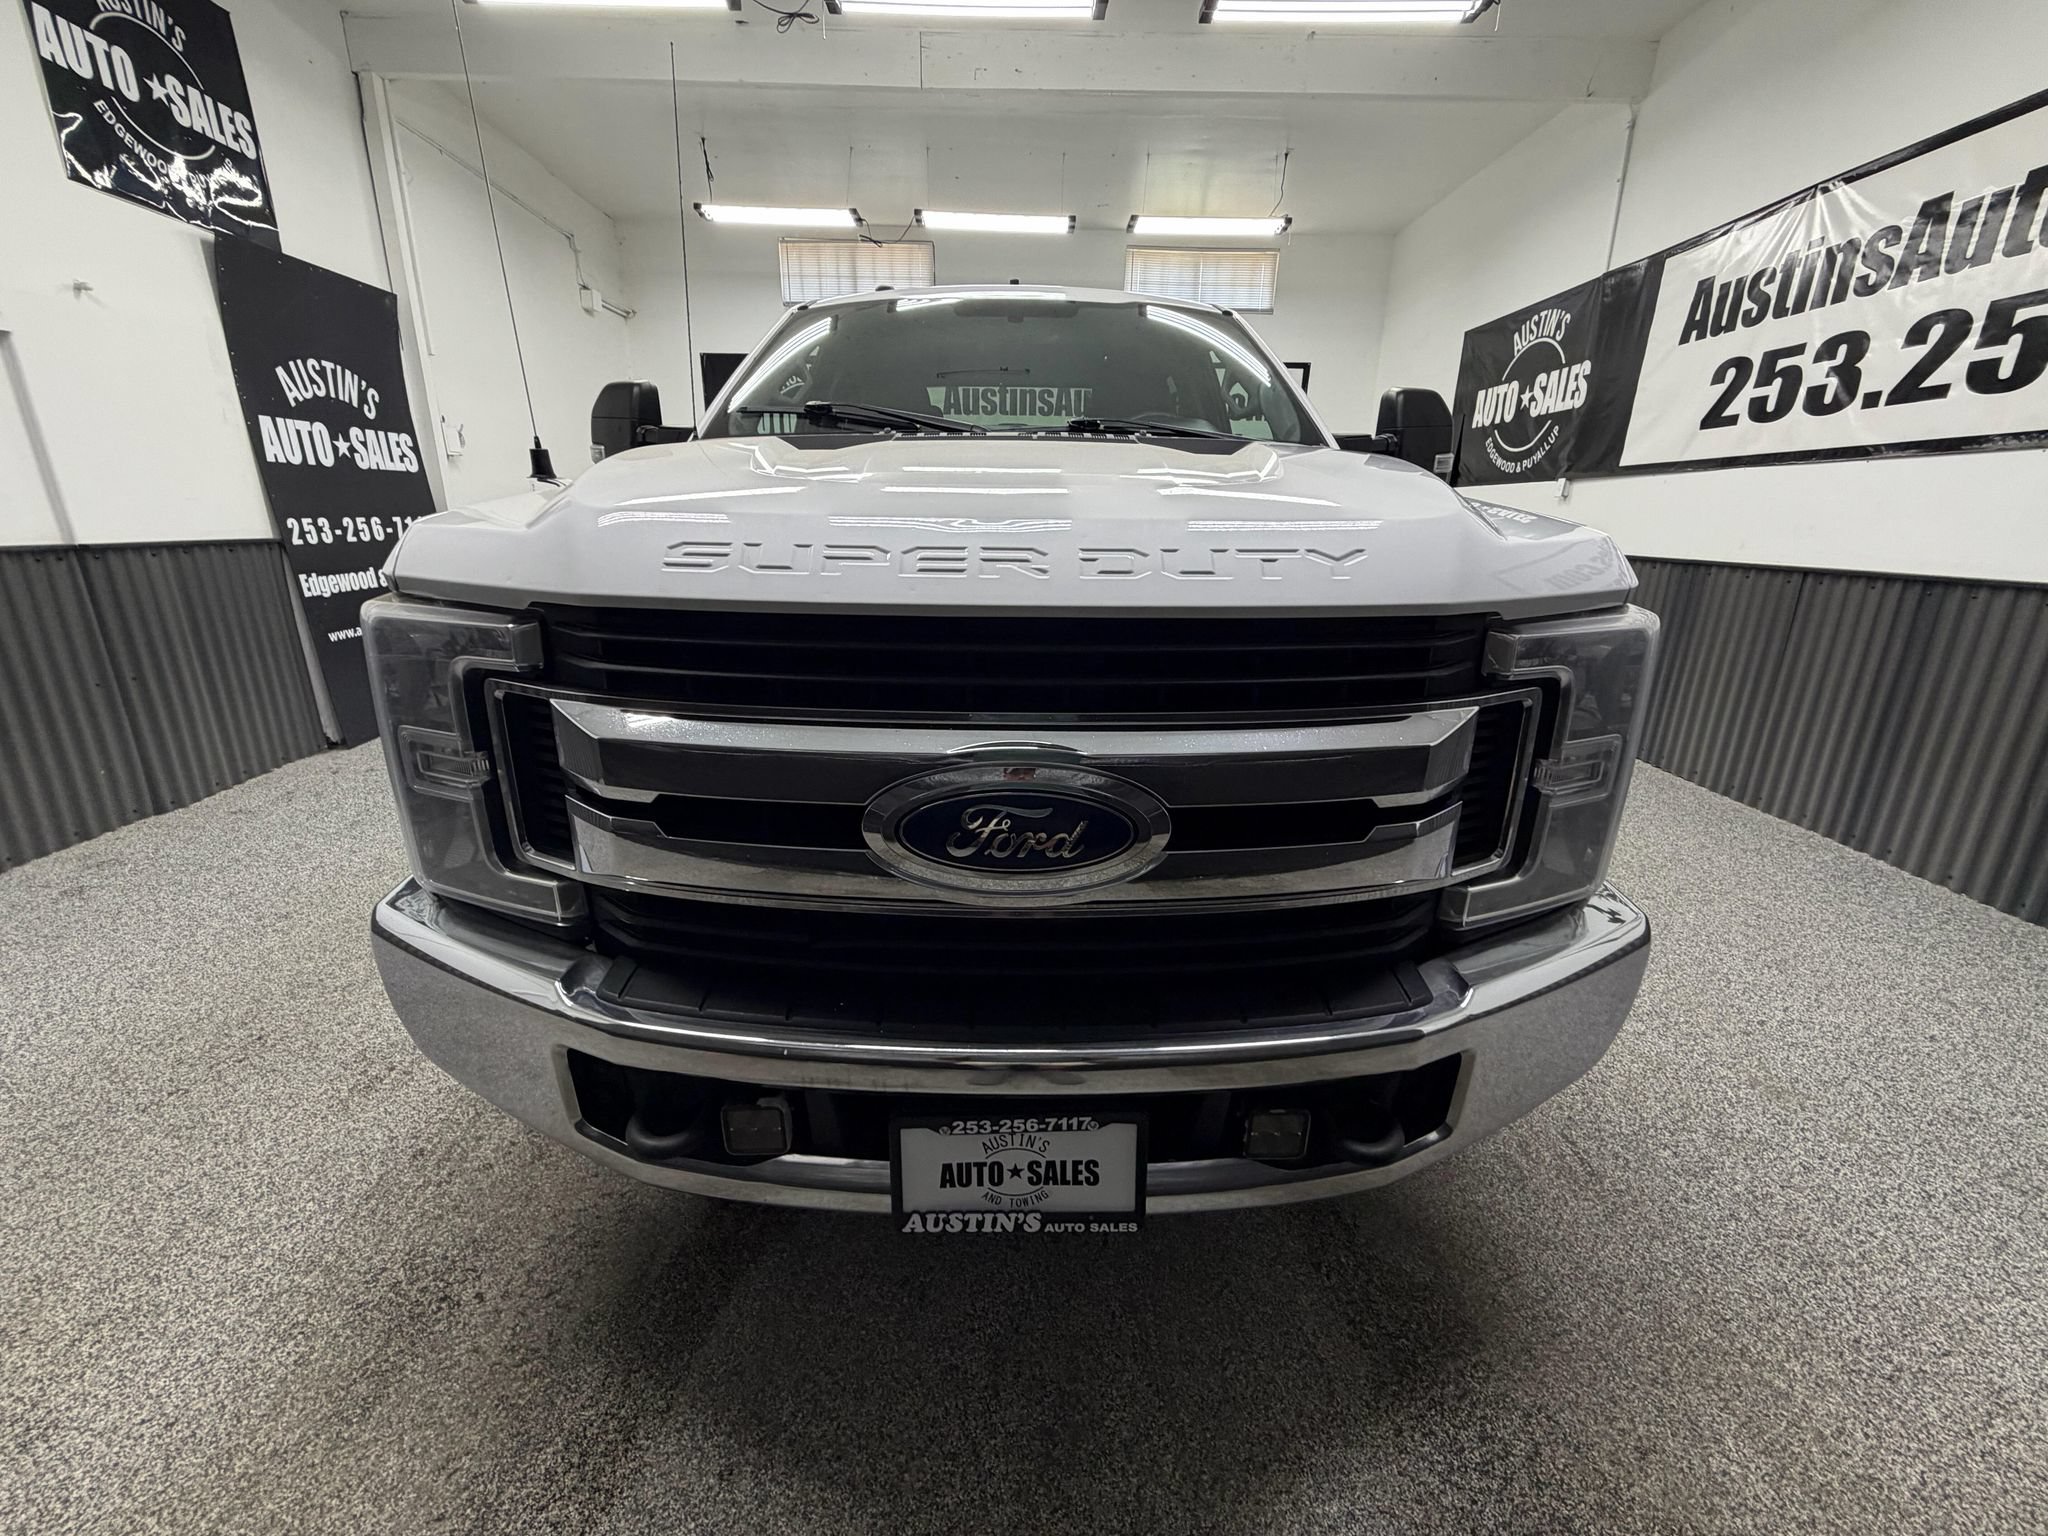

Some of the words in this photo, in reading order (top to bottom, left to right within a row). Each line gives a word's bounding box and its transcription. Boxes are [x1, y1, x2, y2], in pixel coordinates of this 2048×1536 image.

[31, 2, 140, 102] AUTO
[165, 74, 257, 160] SALES
[94, 100, 180, 180] EDGEWOO
[1678, 165, 2048, 346] AustinsAut
[1513, 308, 1571, 356] AUSTIN'S
[275, 358, 380, 420] AUSTIN'S
[1472, 380, 1520, 429] AUTO
[1529, 360, 1592, 418] SALES
[258, 414, 334, 468] AUTO
[349, 426, 419, 473] SALES
[1485, 437, 1515, 473] EDGEWOOD
[1516, 462, 1521, 473] &
[1522, 425, 1559, 471] PUYALLUP
[298, 567, 379, 599] Edgewood
[661, 542, 1050, 579] SUPER
[1079, 548, 1368, 580] DUTY
[946, 804, 1089, 858] Ford
[951, 1117, 1092, 1135] 253-256-7117
[982, 1133, 1050, 1154] AUSTIN'S
[939, 1160, 1004, 1188] AUTO
[1027, 1159, 1100, 1187] SALES
[902, 1212, 1042, 1233] AUSTIN'S
[1044, 1223, 1085, 1233] AUTO
[1090, 1223, 1138, 1233] SALES
[981, 1191, 1002, 1206] AND
[1009, 1190, 1049, 1208] TOWING
